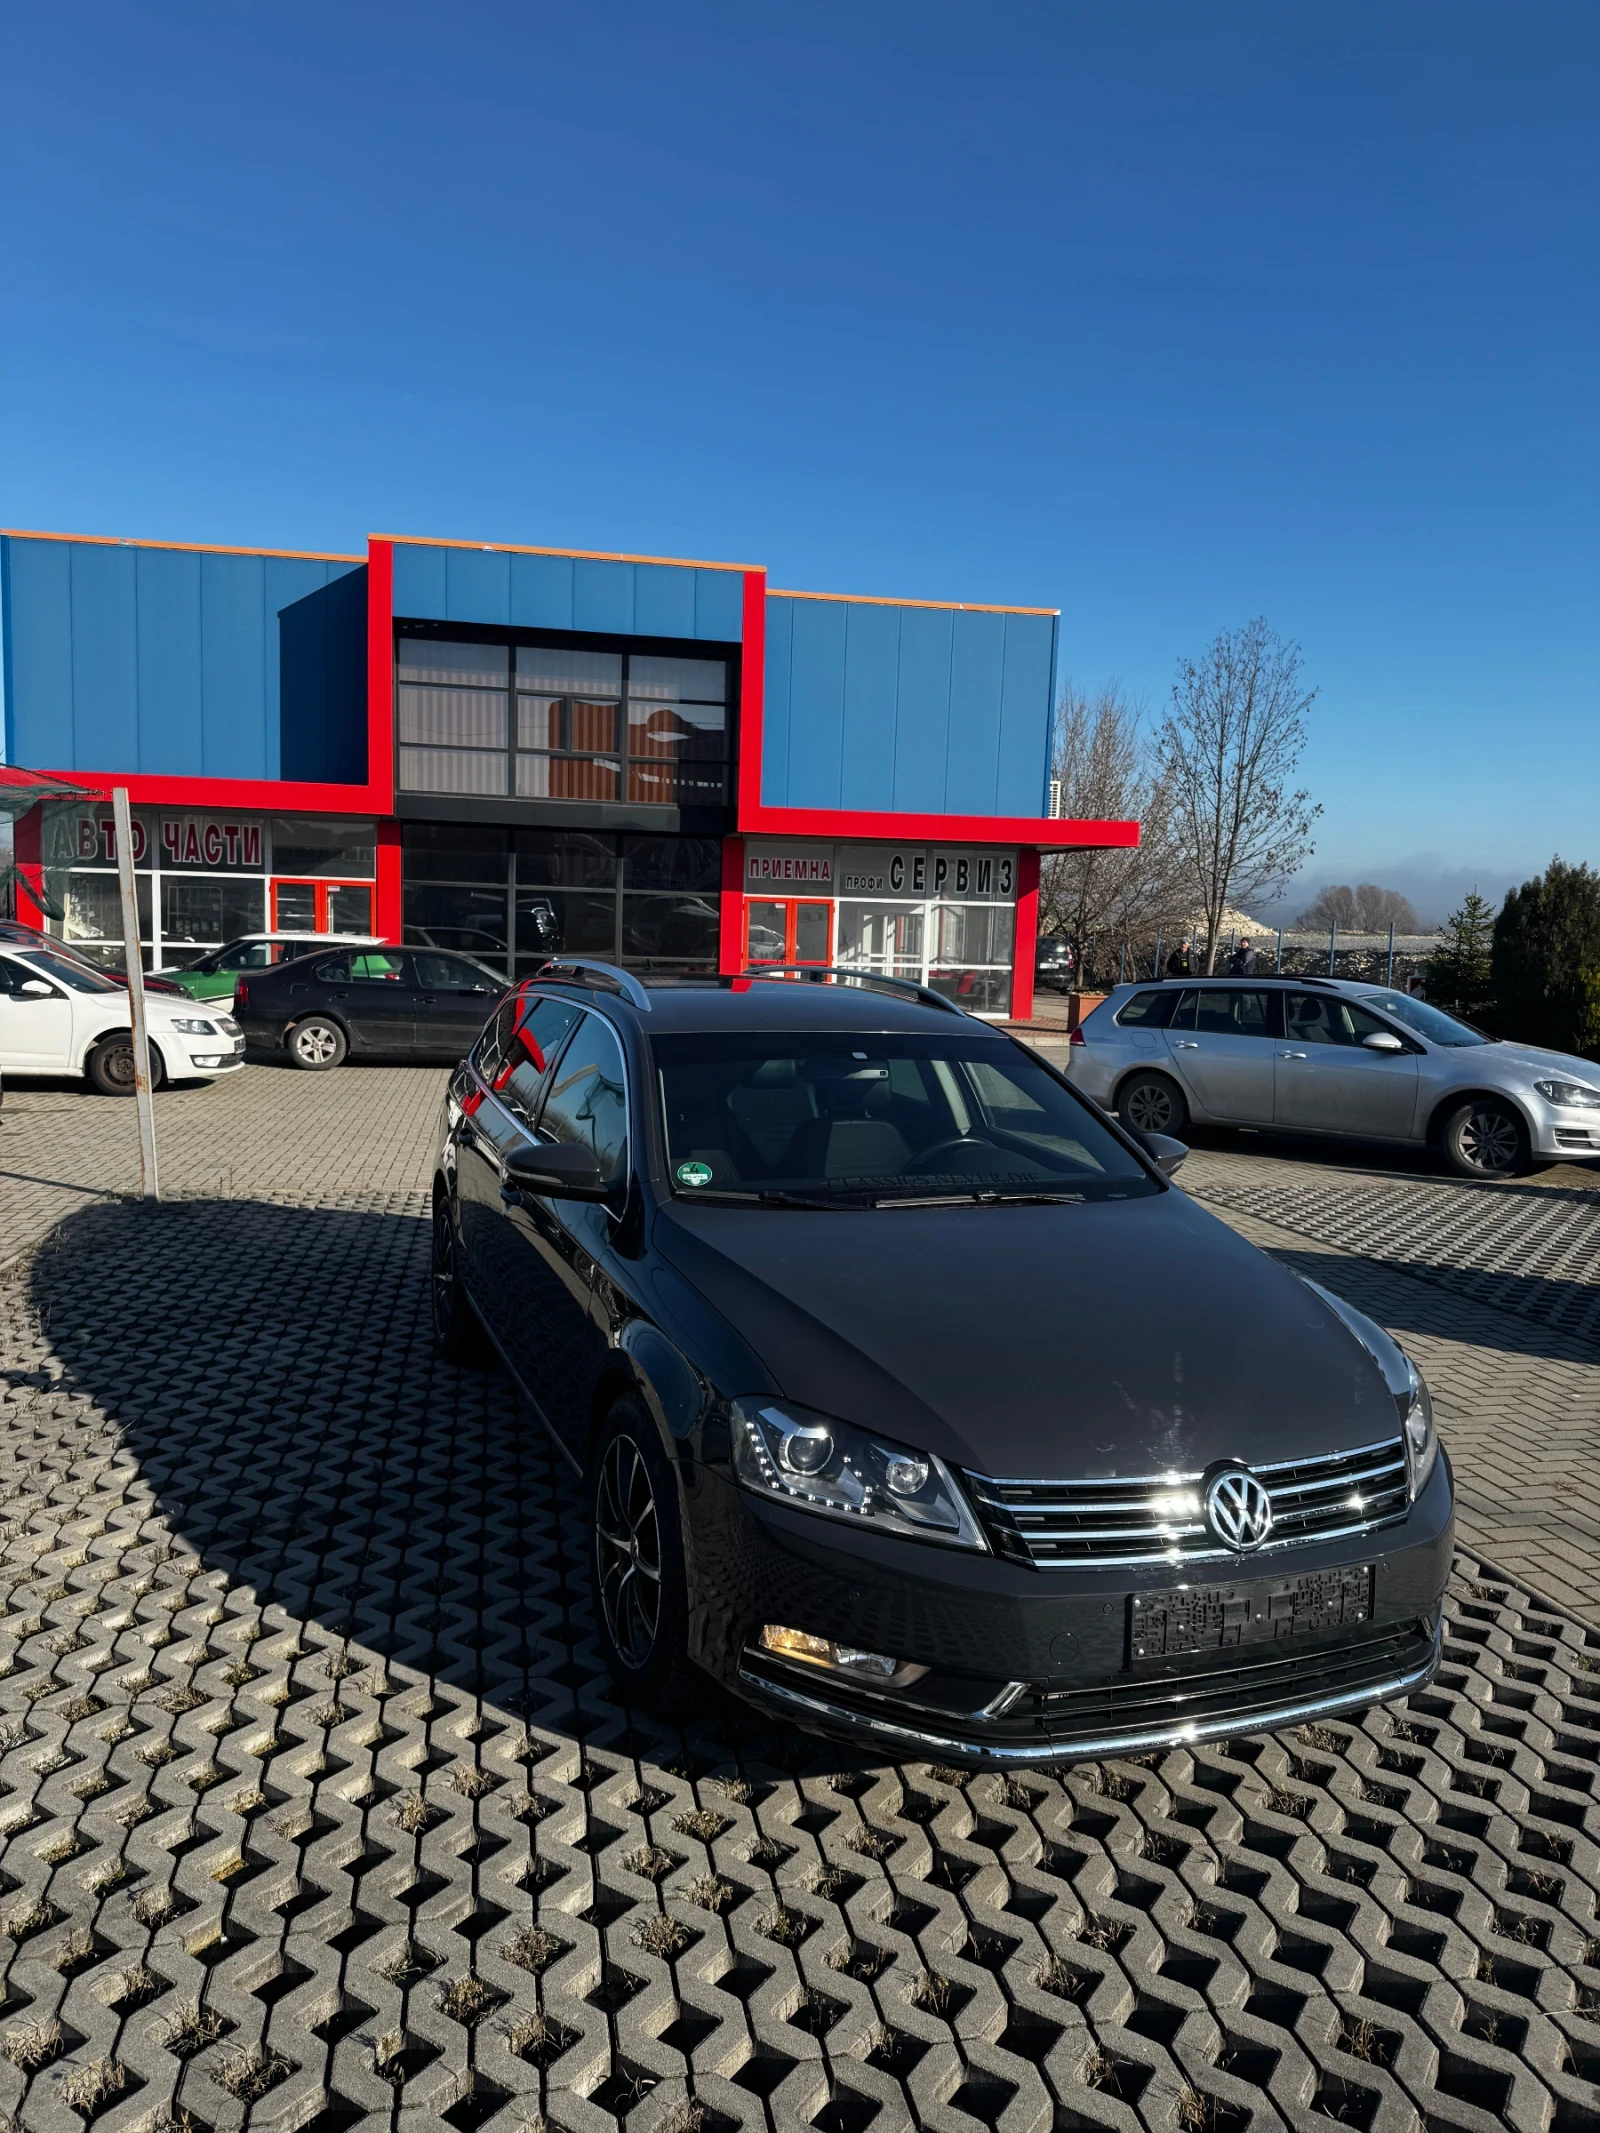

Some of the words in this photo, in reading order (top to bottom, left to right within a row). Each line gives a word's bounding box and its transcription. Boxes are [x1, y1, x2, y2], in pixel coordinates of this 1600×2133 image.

[163, 821, 263, 866] ЧАСТИ
[748, 857, 831, 881] ПРИЕМНА
[845, 874, 884, 891] ПРОФИ
[890, 854, 1014, 895] СЕРВИЗ
[690, 1163, 699, 1174] 4
